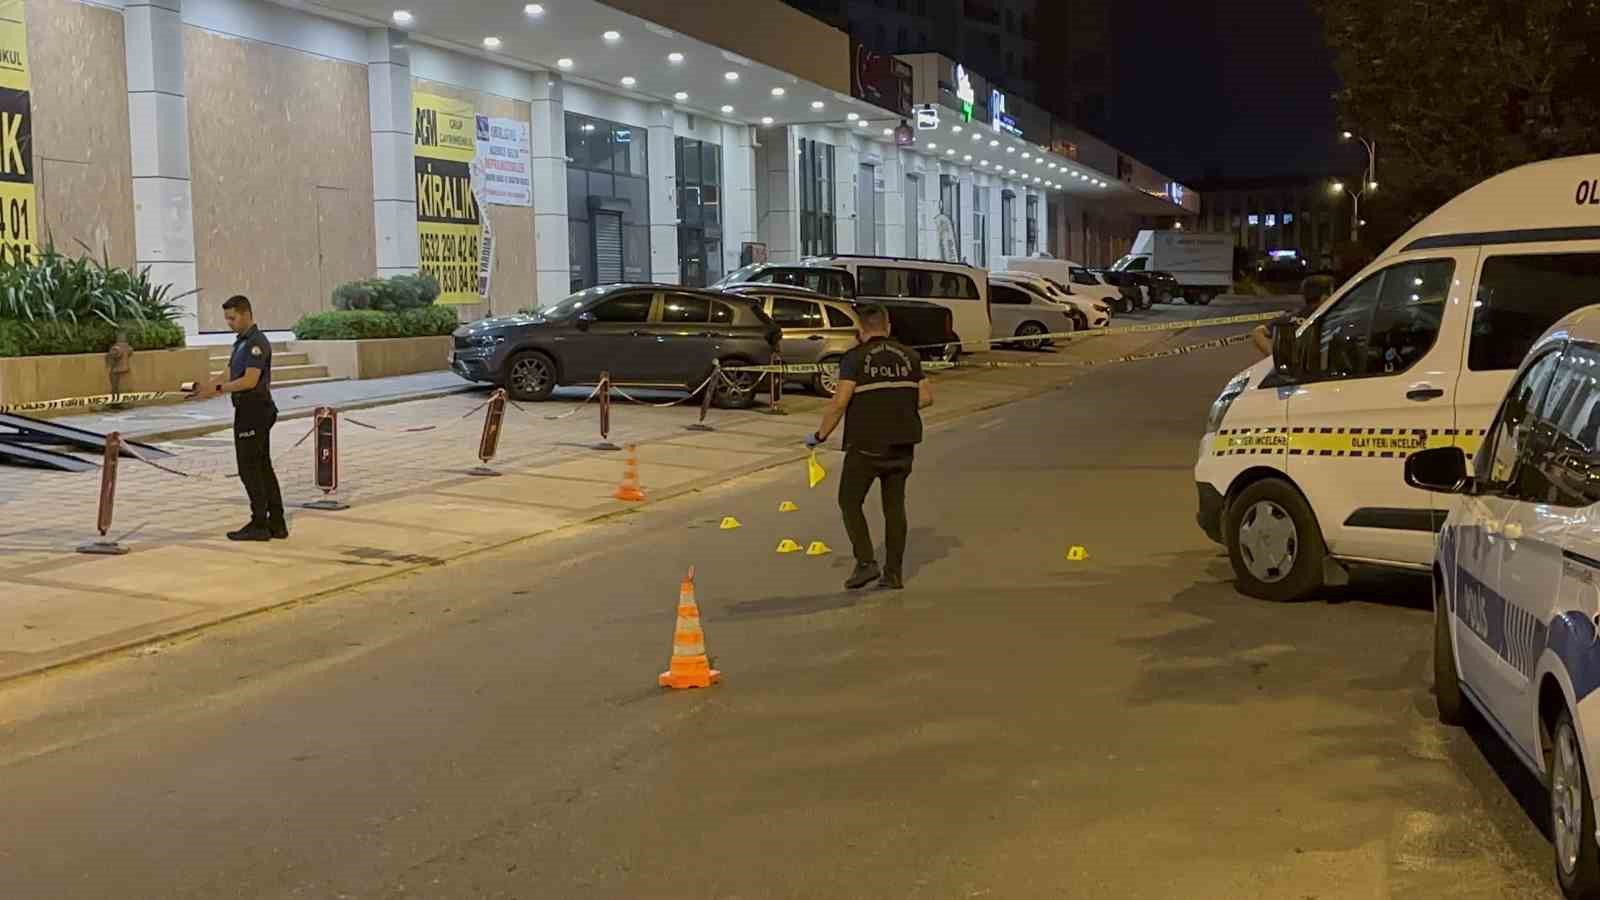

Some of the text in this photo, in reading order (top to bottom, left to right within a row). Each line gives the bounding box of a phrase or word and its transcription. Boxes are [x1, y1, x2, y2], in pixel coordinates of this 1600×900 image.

[417, 163, 476, 219] KİRALIK
[11, 198, 29, 240] 01
[871, 363, 909, 377] POLİS
